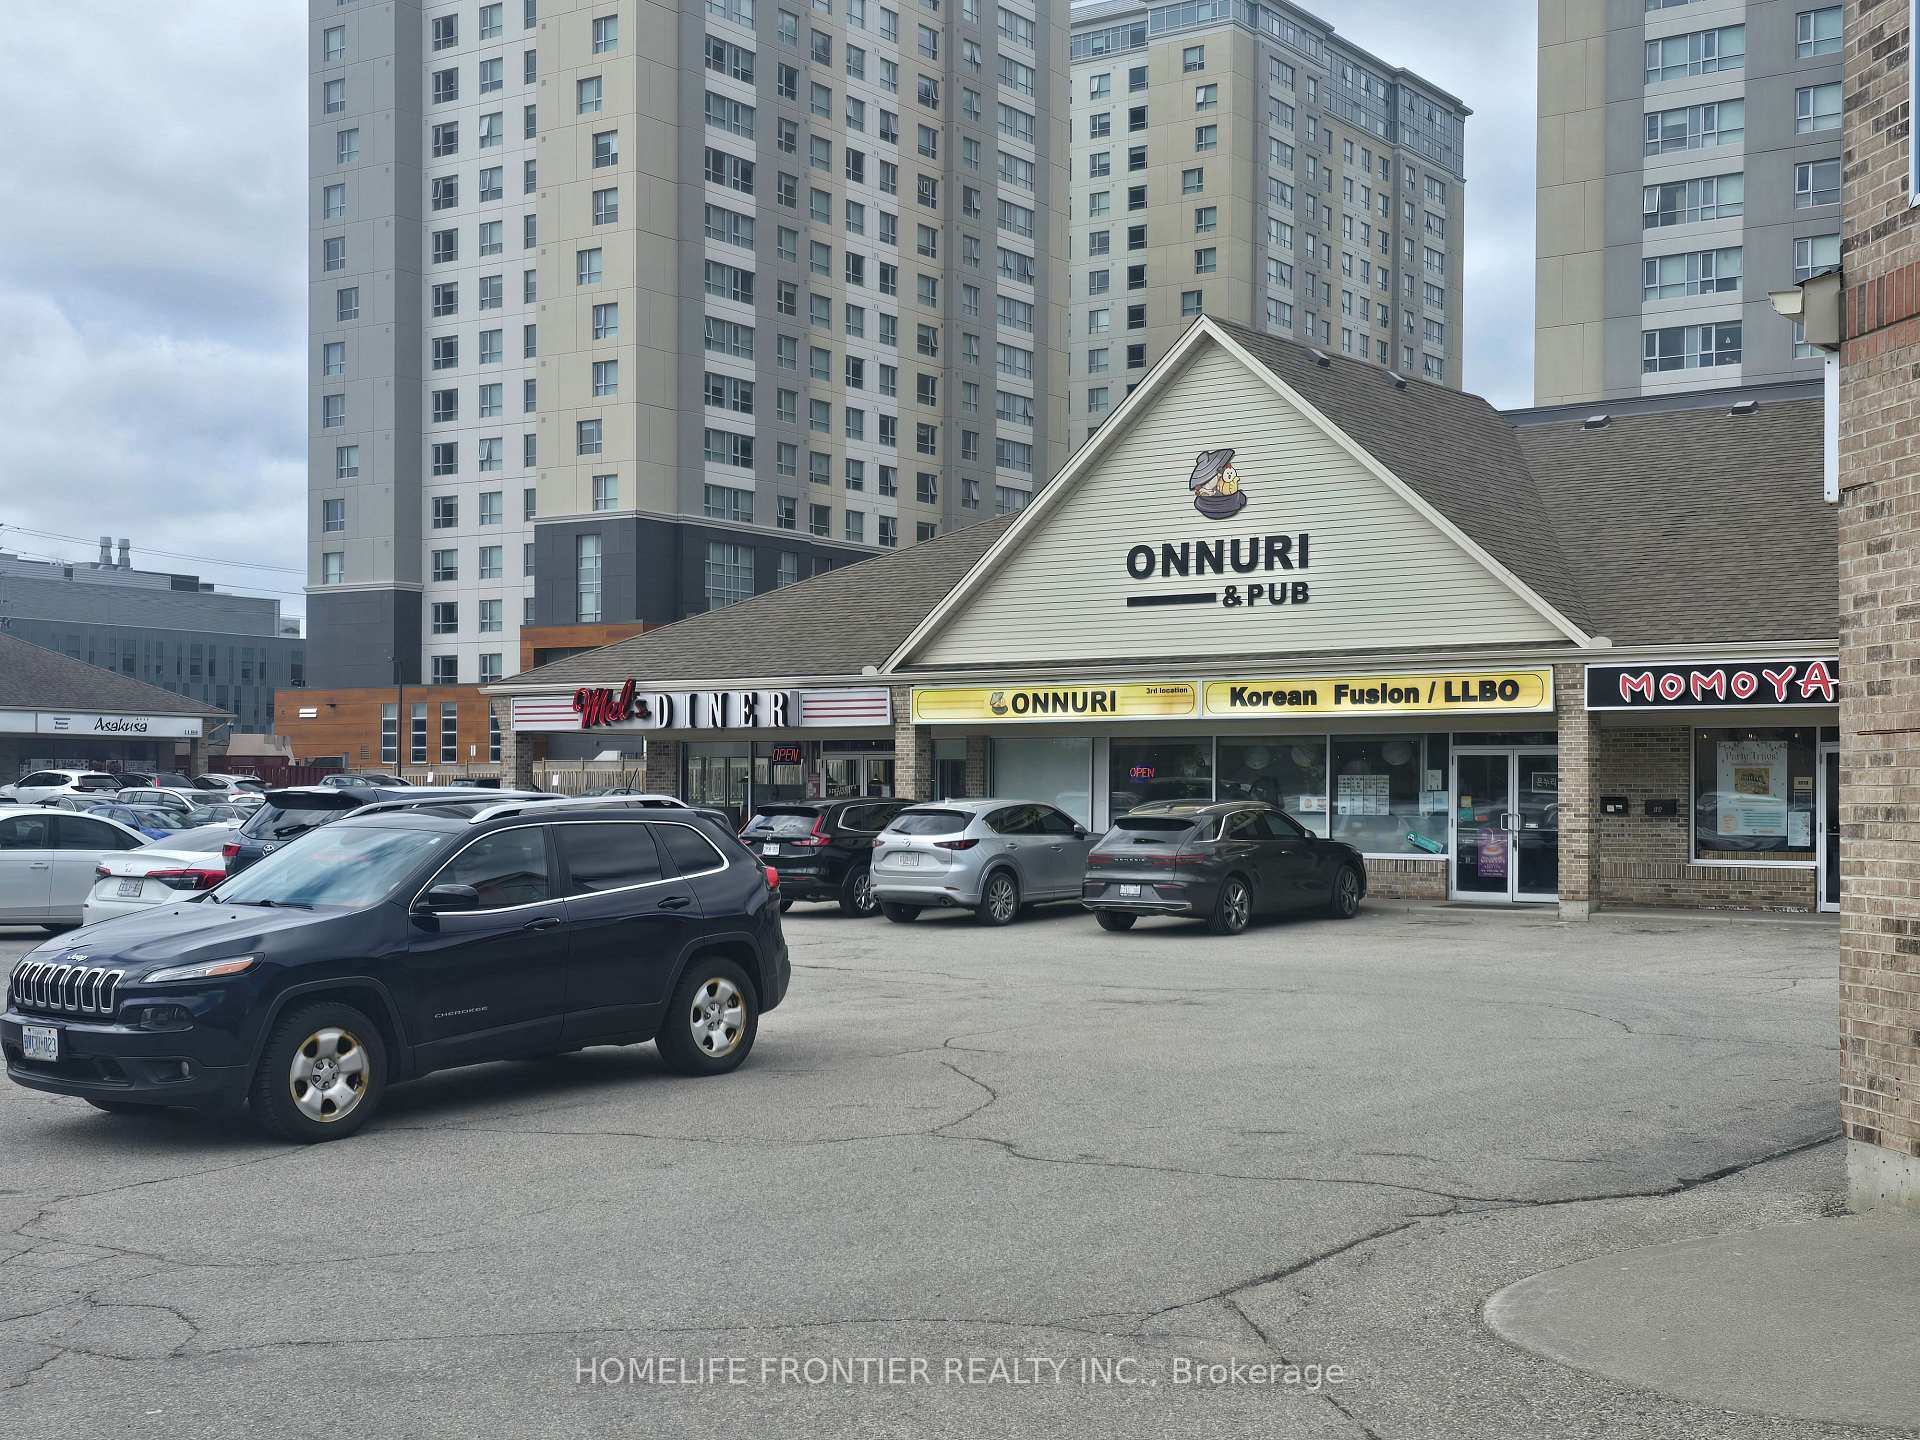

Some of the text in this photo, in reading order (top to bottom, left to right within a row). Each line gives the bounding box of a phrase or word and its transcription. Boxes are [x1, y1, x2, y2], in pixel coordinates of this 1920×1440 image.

[1127, 533, 1309, 579] ONNURI
[1146, 687, 1158, 695] 3rd
[1619, 661, 1839, 703] MOMOYA
[1011, 690, 1116, 714] ONNURI
[1229, 686, 1318, 707] Korean
[1334, 682, 1420, 705] Fusion
[1444, 679, 1520, 703] LLBO
[573, 678, 788, 729] Mel's DINER
[94, 717, 148, 732] Asakusa
[773, 748, 799, 762] OPEN
[1130, 767, 1155, 778] OPEN
[434, 1006, 488, 1019] CHEROKEE
